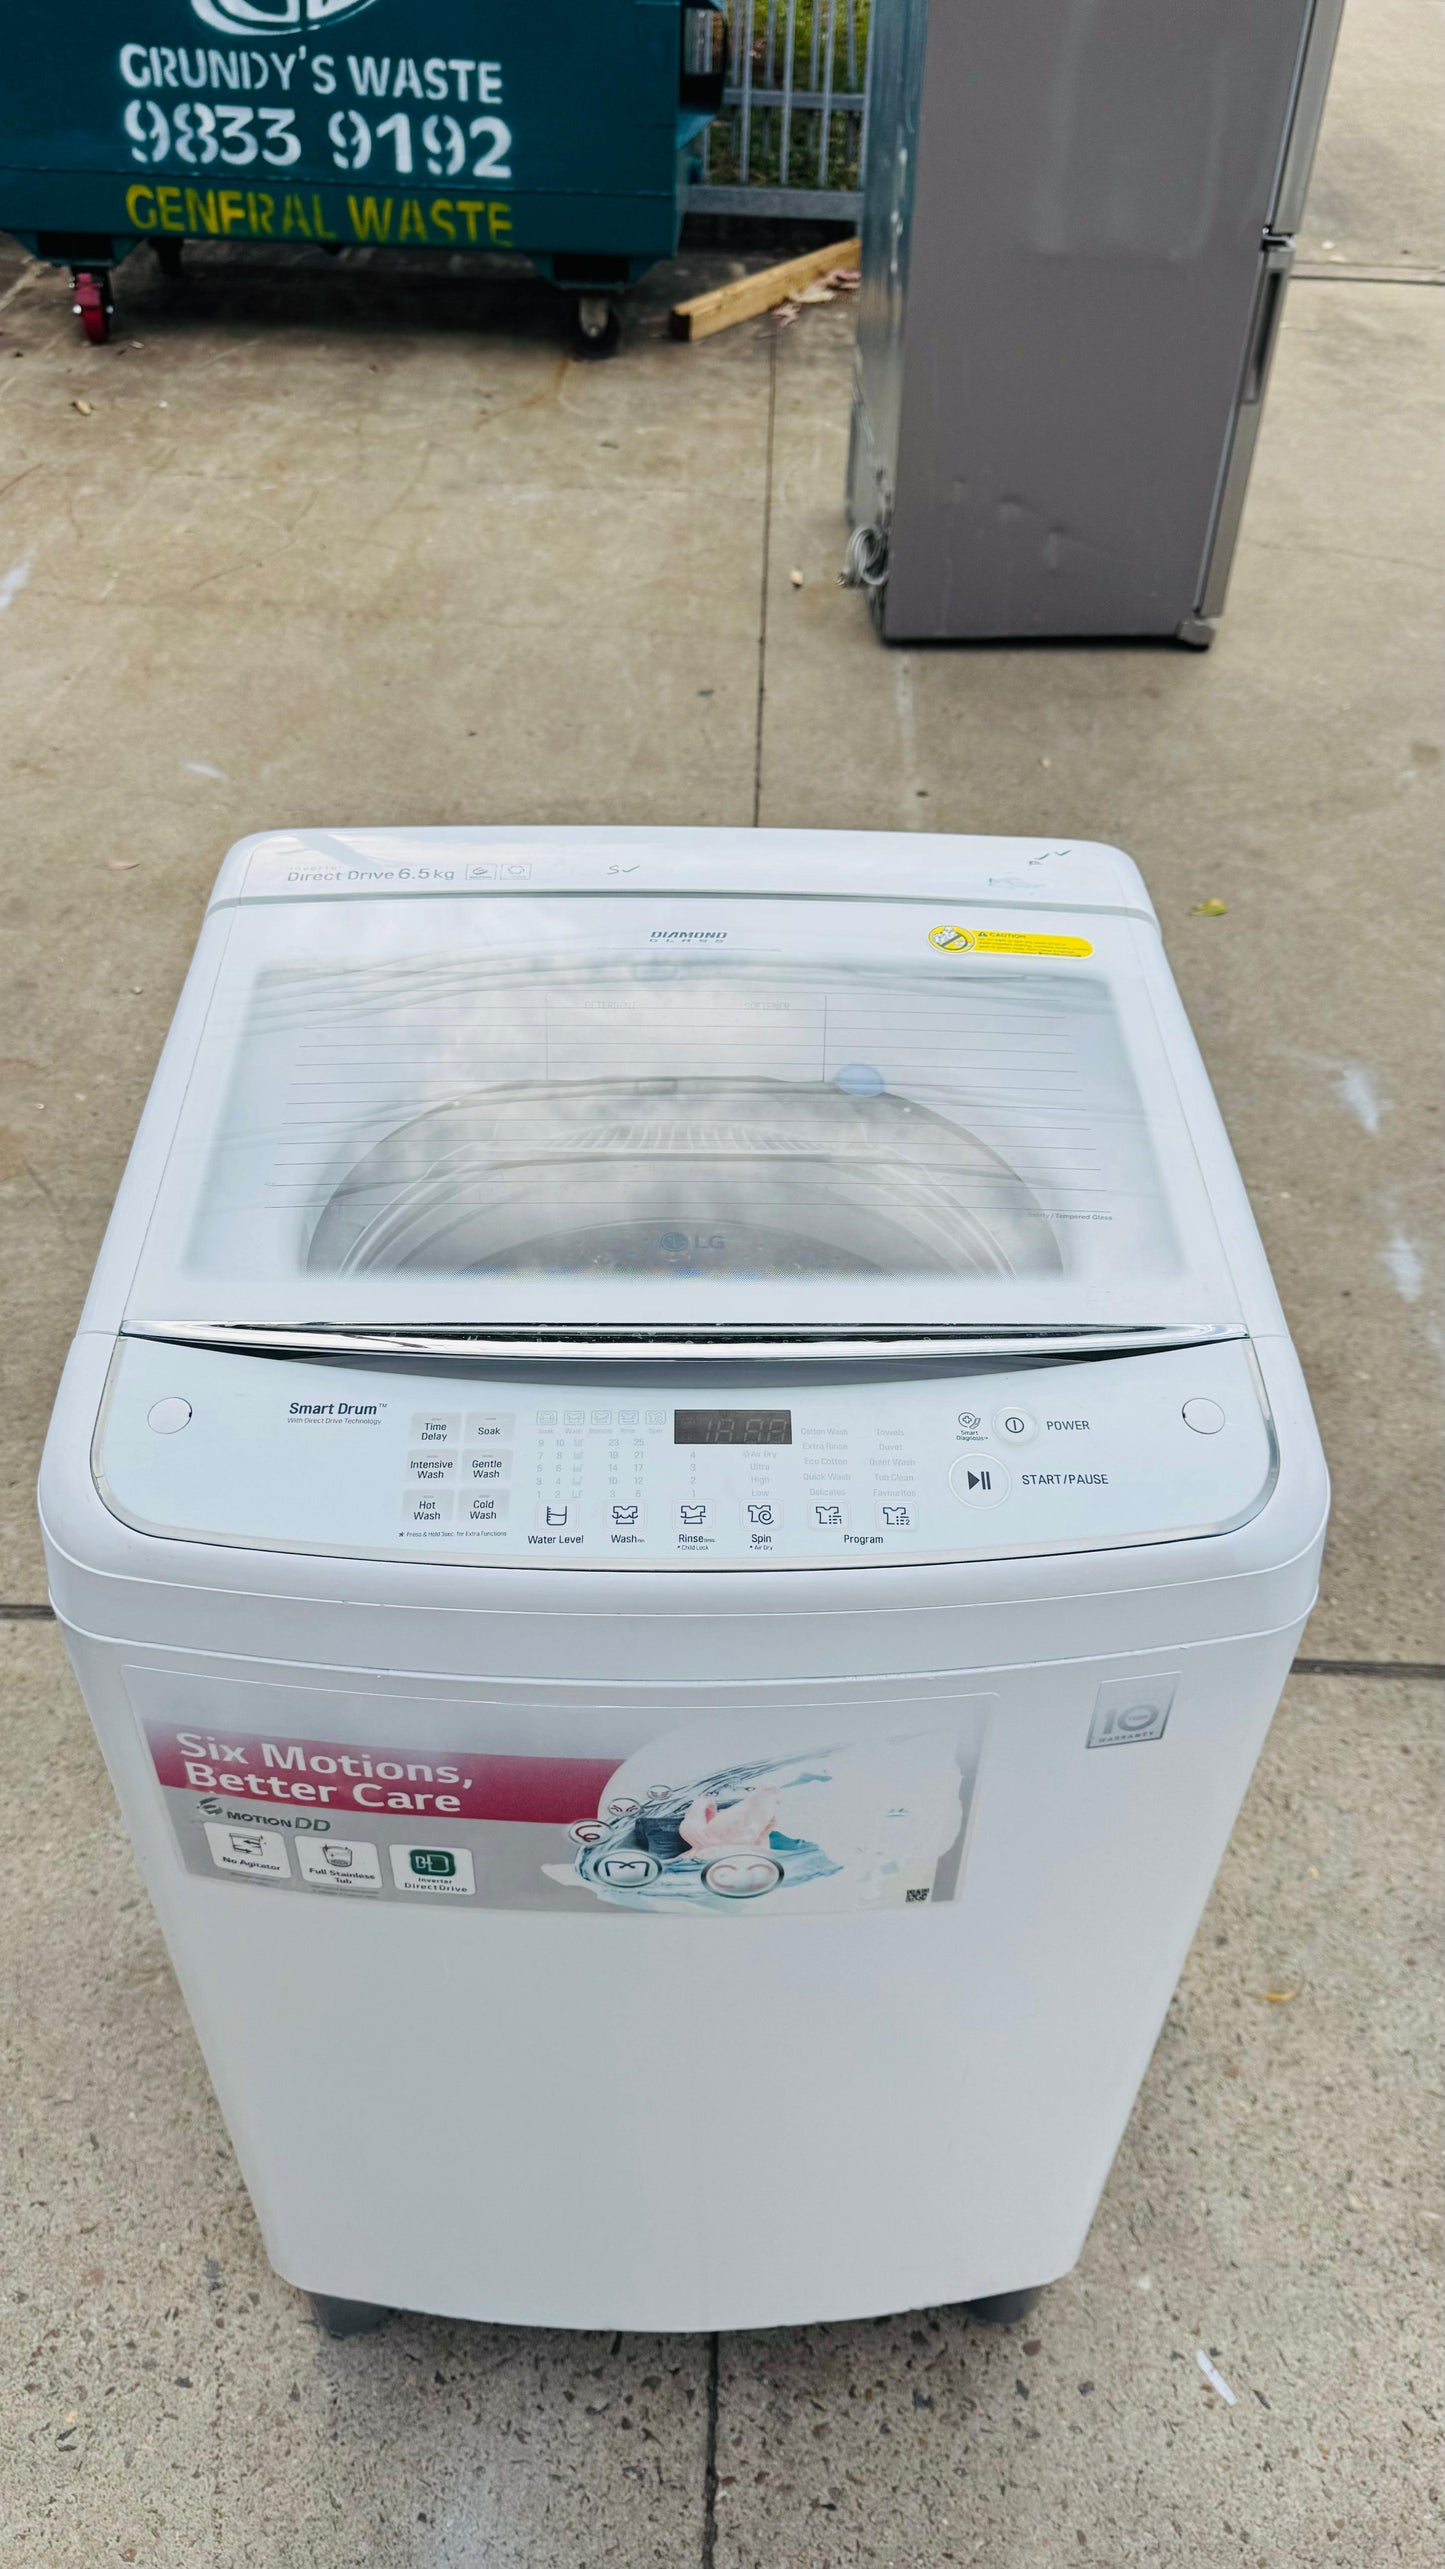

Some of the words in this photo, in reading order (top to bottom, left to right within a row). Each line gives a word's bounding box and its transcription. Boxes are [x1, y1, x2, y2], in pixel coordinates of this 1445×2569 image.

[120, 43, 336, 94] GRUNDY'S
[348, 56, 503, 103] WASTE
[124, 100, 301, 166] 9833
[328, 110, 512, 179] 9192
[348, 195, 513, 248] WASTE
[287, 870, 342, 882] Direct
[348, 870, 394, 881] Drive
[695, 1235, 725, 1250] LG
[289, 1402, 334, 1415] Smart
[424, 1423, 447, 1431] Time
[1047, 1420, 1090, 1431] POWER
[478, 1427, 500, 1435] Soak
[421, 1432, 447, 1442] Delay
[410, 1460, 453, 1469] Intensive
[472, 1460, 502, 1468] Gentle
[821, 1457, 848, 1465] Cotton
[609, 1464, 618, 1472] 14
[634, 1464, 643, 1472] 17
[417, 1470, 444, 1479] Wash
[473, 1470, 500, 1478] Wash
[1021, 1474, 1109, 1485] START/PAUSE
[610, 1490, 615, 1498] 3
[752, 1489, 770, 1497] Low
[419, 1501, 435, 1509] Hot
[473, 1500, 494, 1509] Cold
[413, 1512, 441, 1520] Wash
[469, 1511, 497, 1520] Wash
[528, 1535, 556, 1544] Water
[559, 1535, 584, 1543] Level
[611, 1535, 637, 1543] Wash
[678, 1534, 703, 1543] Rinse
[751, 1534, 772, 1544] Spin
[844, 1534, 884, 1545] Program
[176, 1732, 248, 1764] Six
[261, 1743, 473, 1789] Motions,
[185, 1761, 338, 1803] Better
[353, 1783, 461, 1812] Care
[222, 1856, 237, 1864] No
[240, 1860, 280, 1871] Agitator
[309, 1867, 327, 1876] Full
[329, 1870, 375, 1880] Stainless
[334, 1877, 352, 1885] Tub
